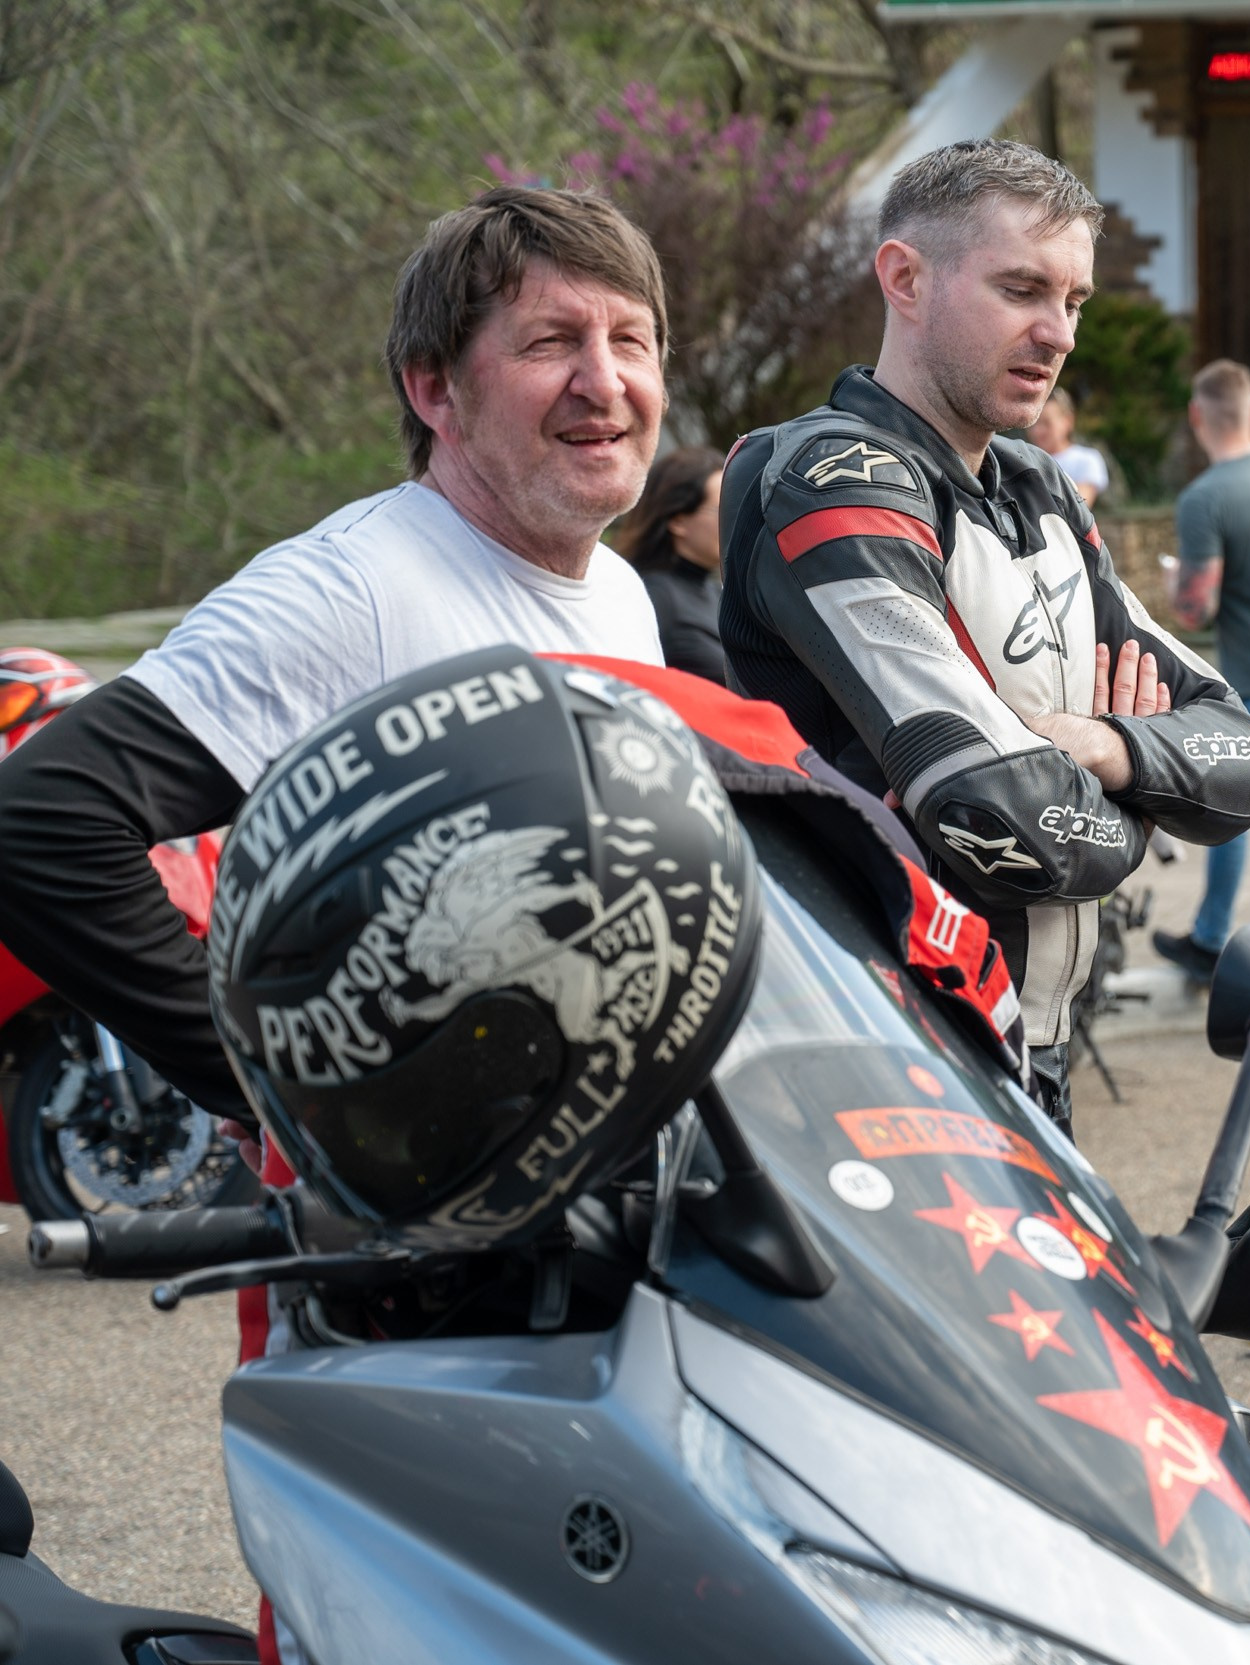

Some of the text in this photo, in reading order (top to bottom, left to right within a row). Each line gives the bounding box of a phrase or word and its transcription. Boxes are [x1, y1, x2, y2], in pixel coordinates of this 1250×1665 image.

[238, 729, 374, 872] WIDE
[374, 664, 544, 758] OPEN
[256, 801, 490, 1086] PERFORMANCE
[515, 1074, 627, 1182] FULL
[653, 860, 743, 1063] THROTTLE
[592, 905, 652, 960] 1971
